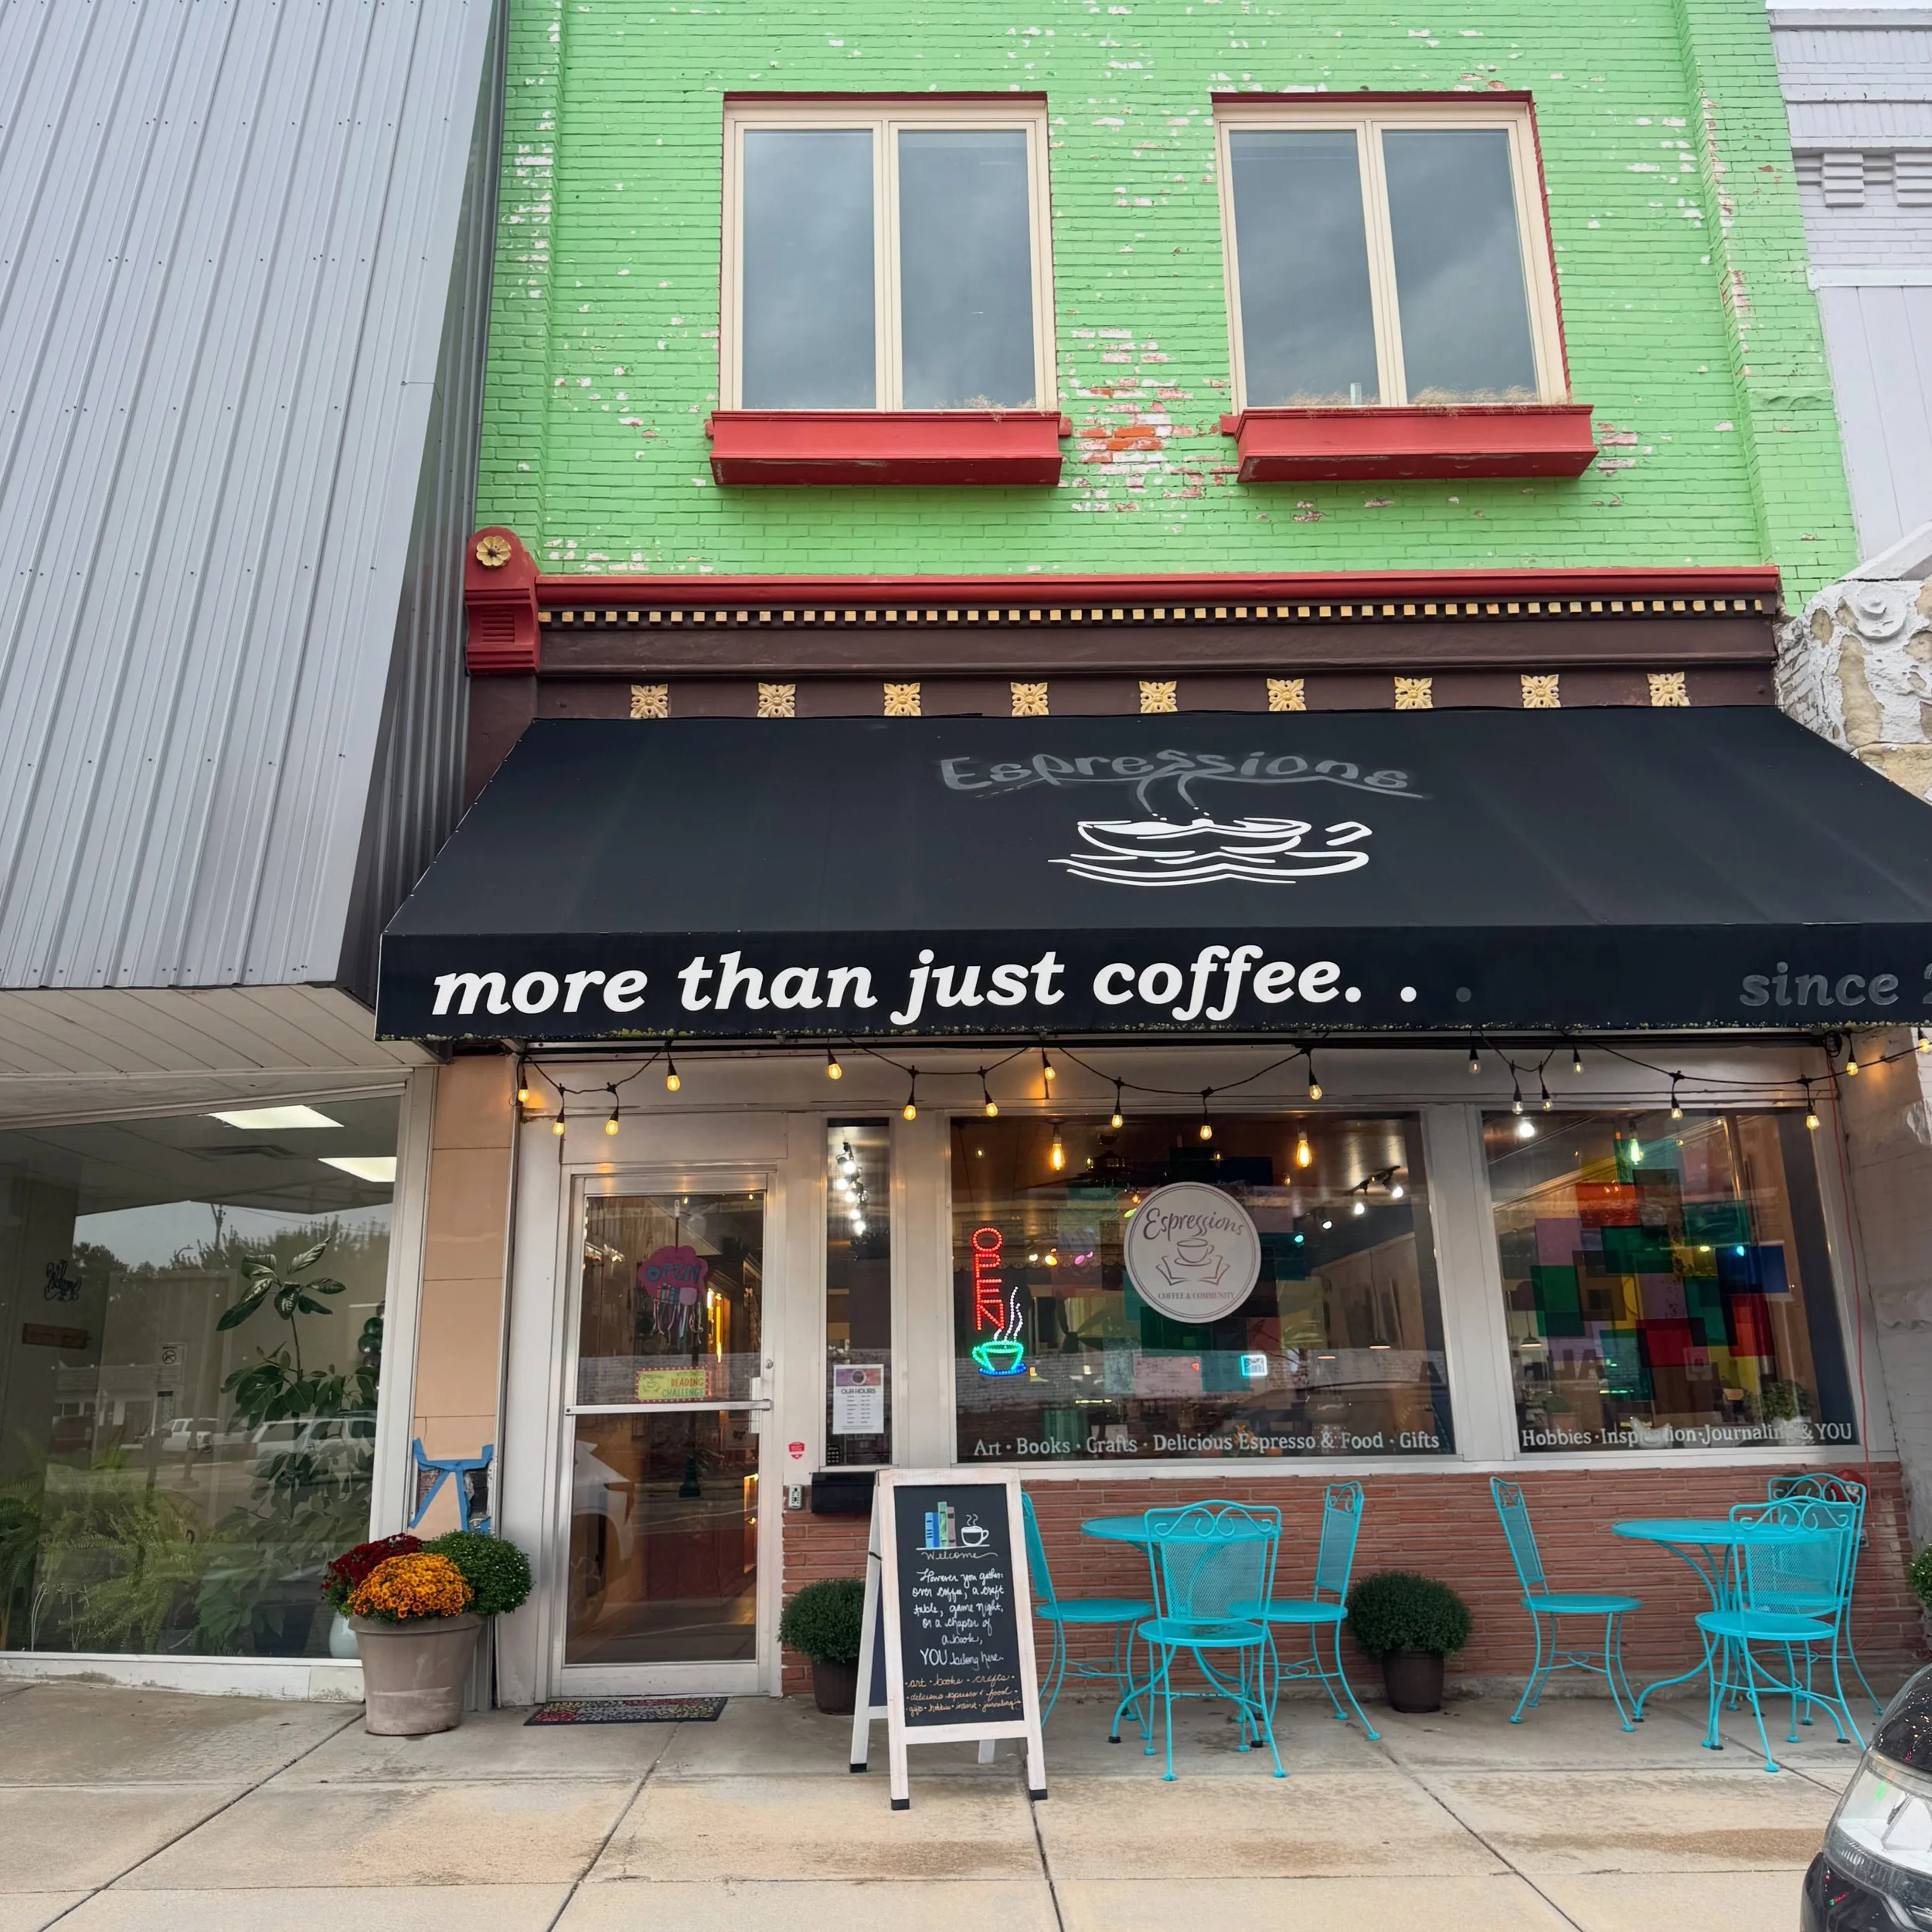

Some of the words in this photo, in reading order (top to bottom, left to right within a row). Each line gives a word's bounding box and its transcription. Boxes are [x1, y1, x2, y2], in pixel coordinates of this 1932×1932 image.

[941, 750, 1409, 791] Espressions
[431, 969, 648, 1015] more
[677, 951, 878, 1012] than
[889, 949, 1065, 1026] just
[1739, 961, 1899, 1006] since
[1143, 1207, 1246, 1242] Espressions
[971, 1226, 1005, 1331] OPEN
[1192, 1291, 1235, 1300] COMMUNITY
[670, 1377, 705, 1388] READING
[662, 1387, 704, 1398] CHALLENGE
[974, 1438, 1002, 1456] Art
[1016, 1437, 1071, 1454] Books
[1086, 1434, 1138, 1454] Crafts
[1152, 1433, 1233, 1451] Delicious
[1239, 1433, 1315, 1454] Espresso
[1321, 1434, 1335, 1449] &
[1339, 1432, 1383, 1450] Food
[1400, 1431, 1440, 1449] Gifts
[1522, 1428, 1592, 1447] Hobbies
[1600, 1425, 1697, 1447] Inspion
[1798, 1423, 1813, 1440] &
[1815, 1423, 1852, 1440] YOU
[921, 1550, 998, 1560] Welcome
[916, 1568, 958, 1583] However
[961, 1573, 978, 1589] you
[912, 1587, 933, 1598] over
[972, 1587, 979, 1595] a
[981, 1585, 1005, 1600] craft
[949, 1604, 974, 1619] game
[922, 1617, 932, 1628] or
[935, 1619, 942, 1628] a
[944, 1617, 979, 1634] chapter
[982, 1617, 992, 1636] of
[941, 1634, 948, 1645] a
[920, 1648, 947, 1665] YOU
[950, 1652, 979, 1671] belong
[907, 1678, 927, 1687] art
[934, 1673, 963, 1685] books
[971, 1674, 1011, 1687] crafts
[985, 1686, 1012, 1700] food
